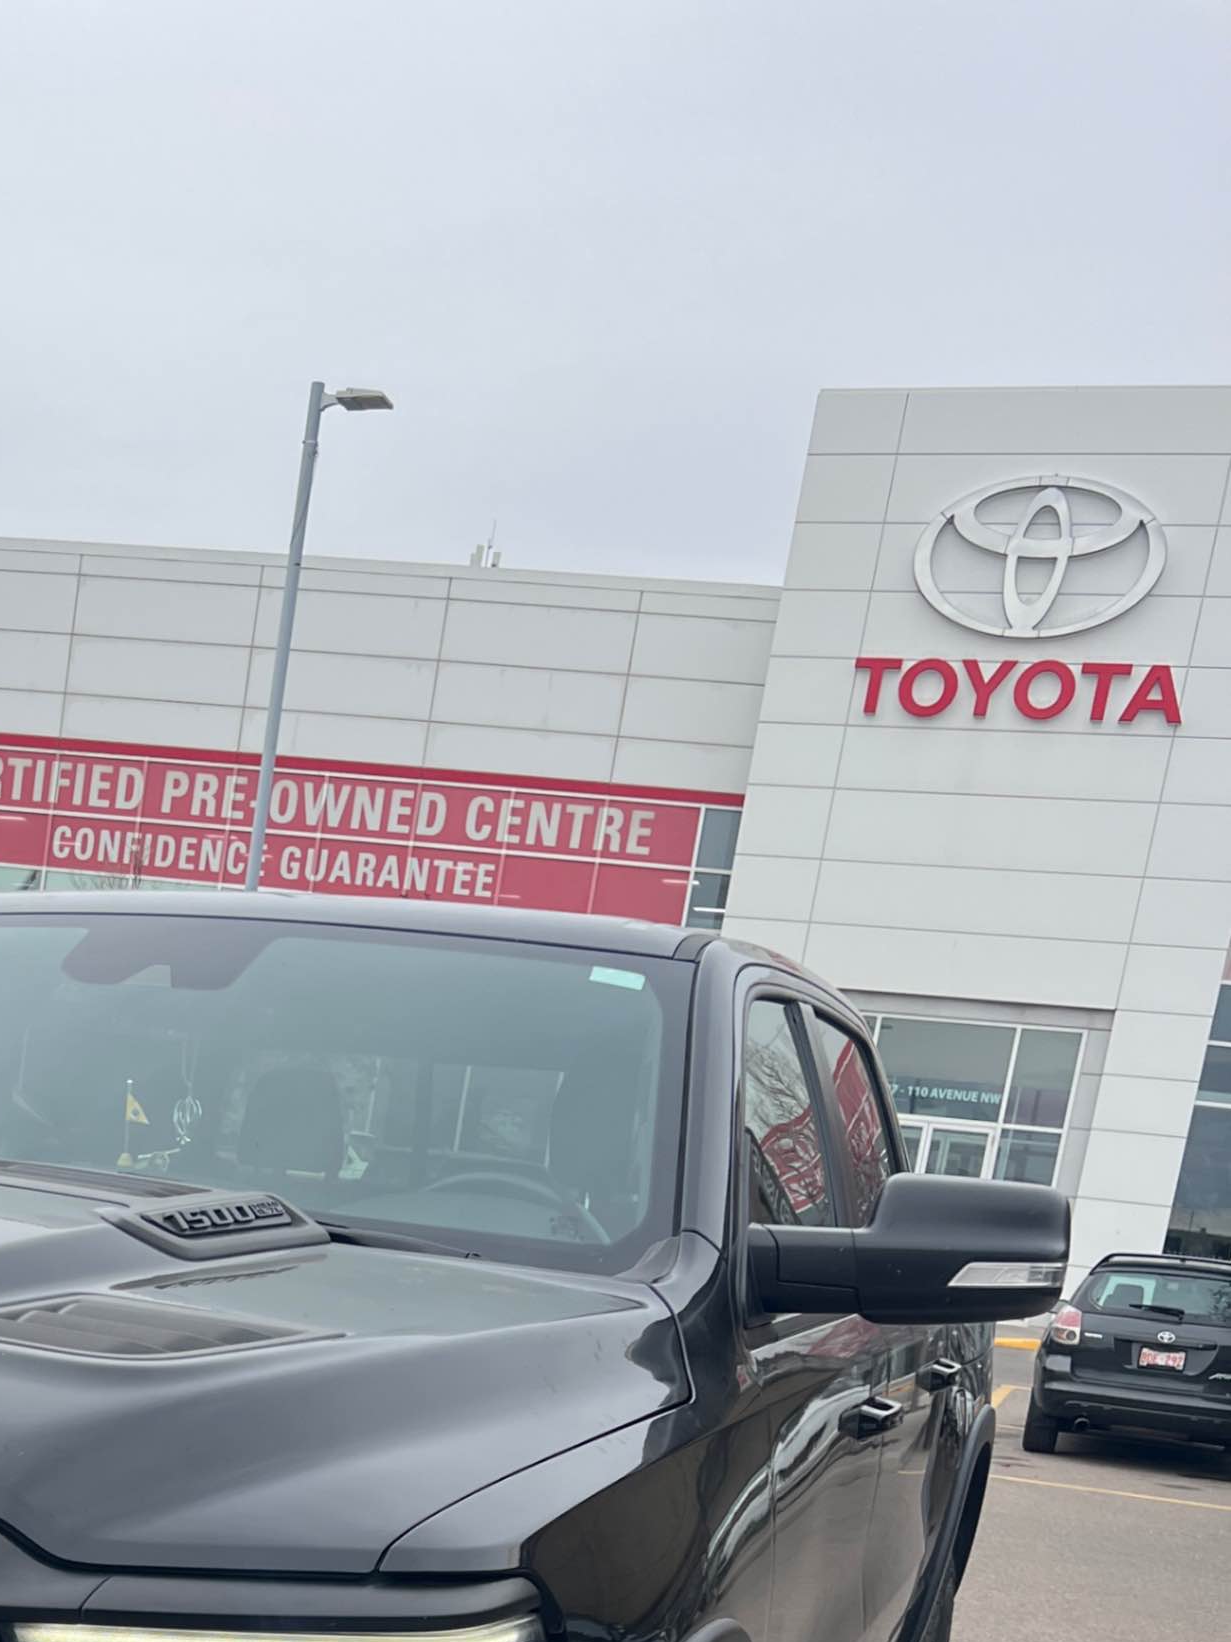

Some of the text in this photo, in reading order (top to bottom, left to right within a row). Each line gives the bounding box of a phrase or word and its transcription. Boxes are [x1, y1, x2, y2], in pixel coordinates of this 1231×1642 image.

[855, 657, 1182, 726] TOYOTA
[465, 794, 657, 856] CENTRE
[279, 845, 497, 898] GUARANTEE
[907, 1085, 928, 1098] 110
[930, 1087, 979, 1103] AVENUE
[980, 1091, 1002, 1105] NW
[163, 1204, 257, 1231] 1500
